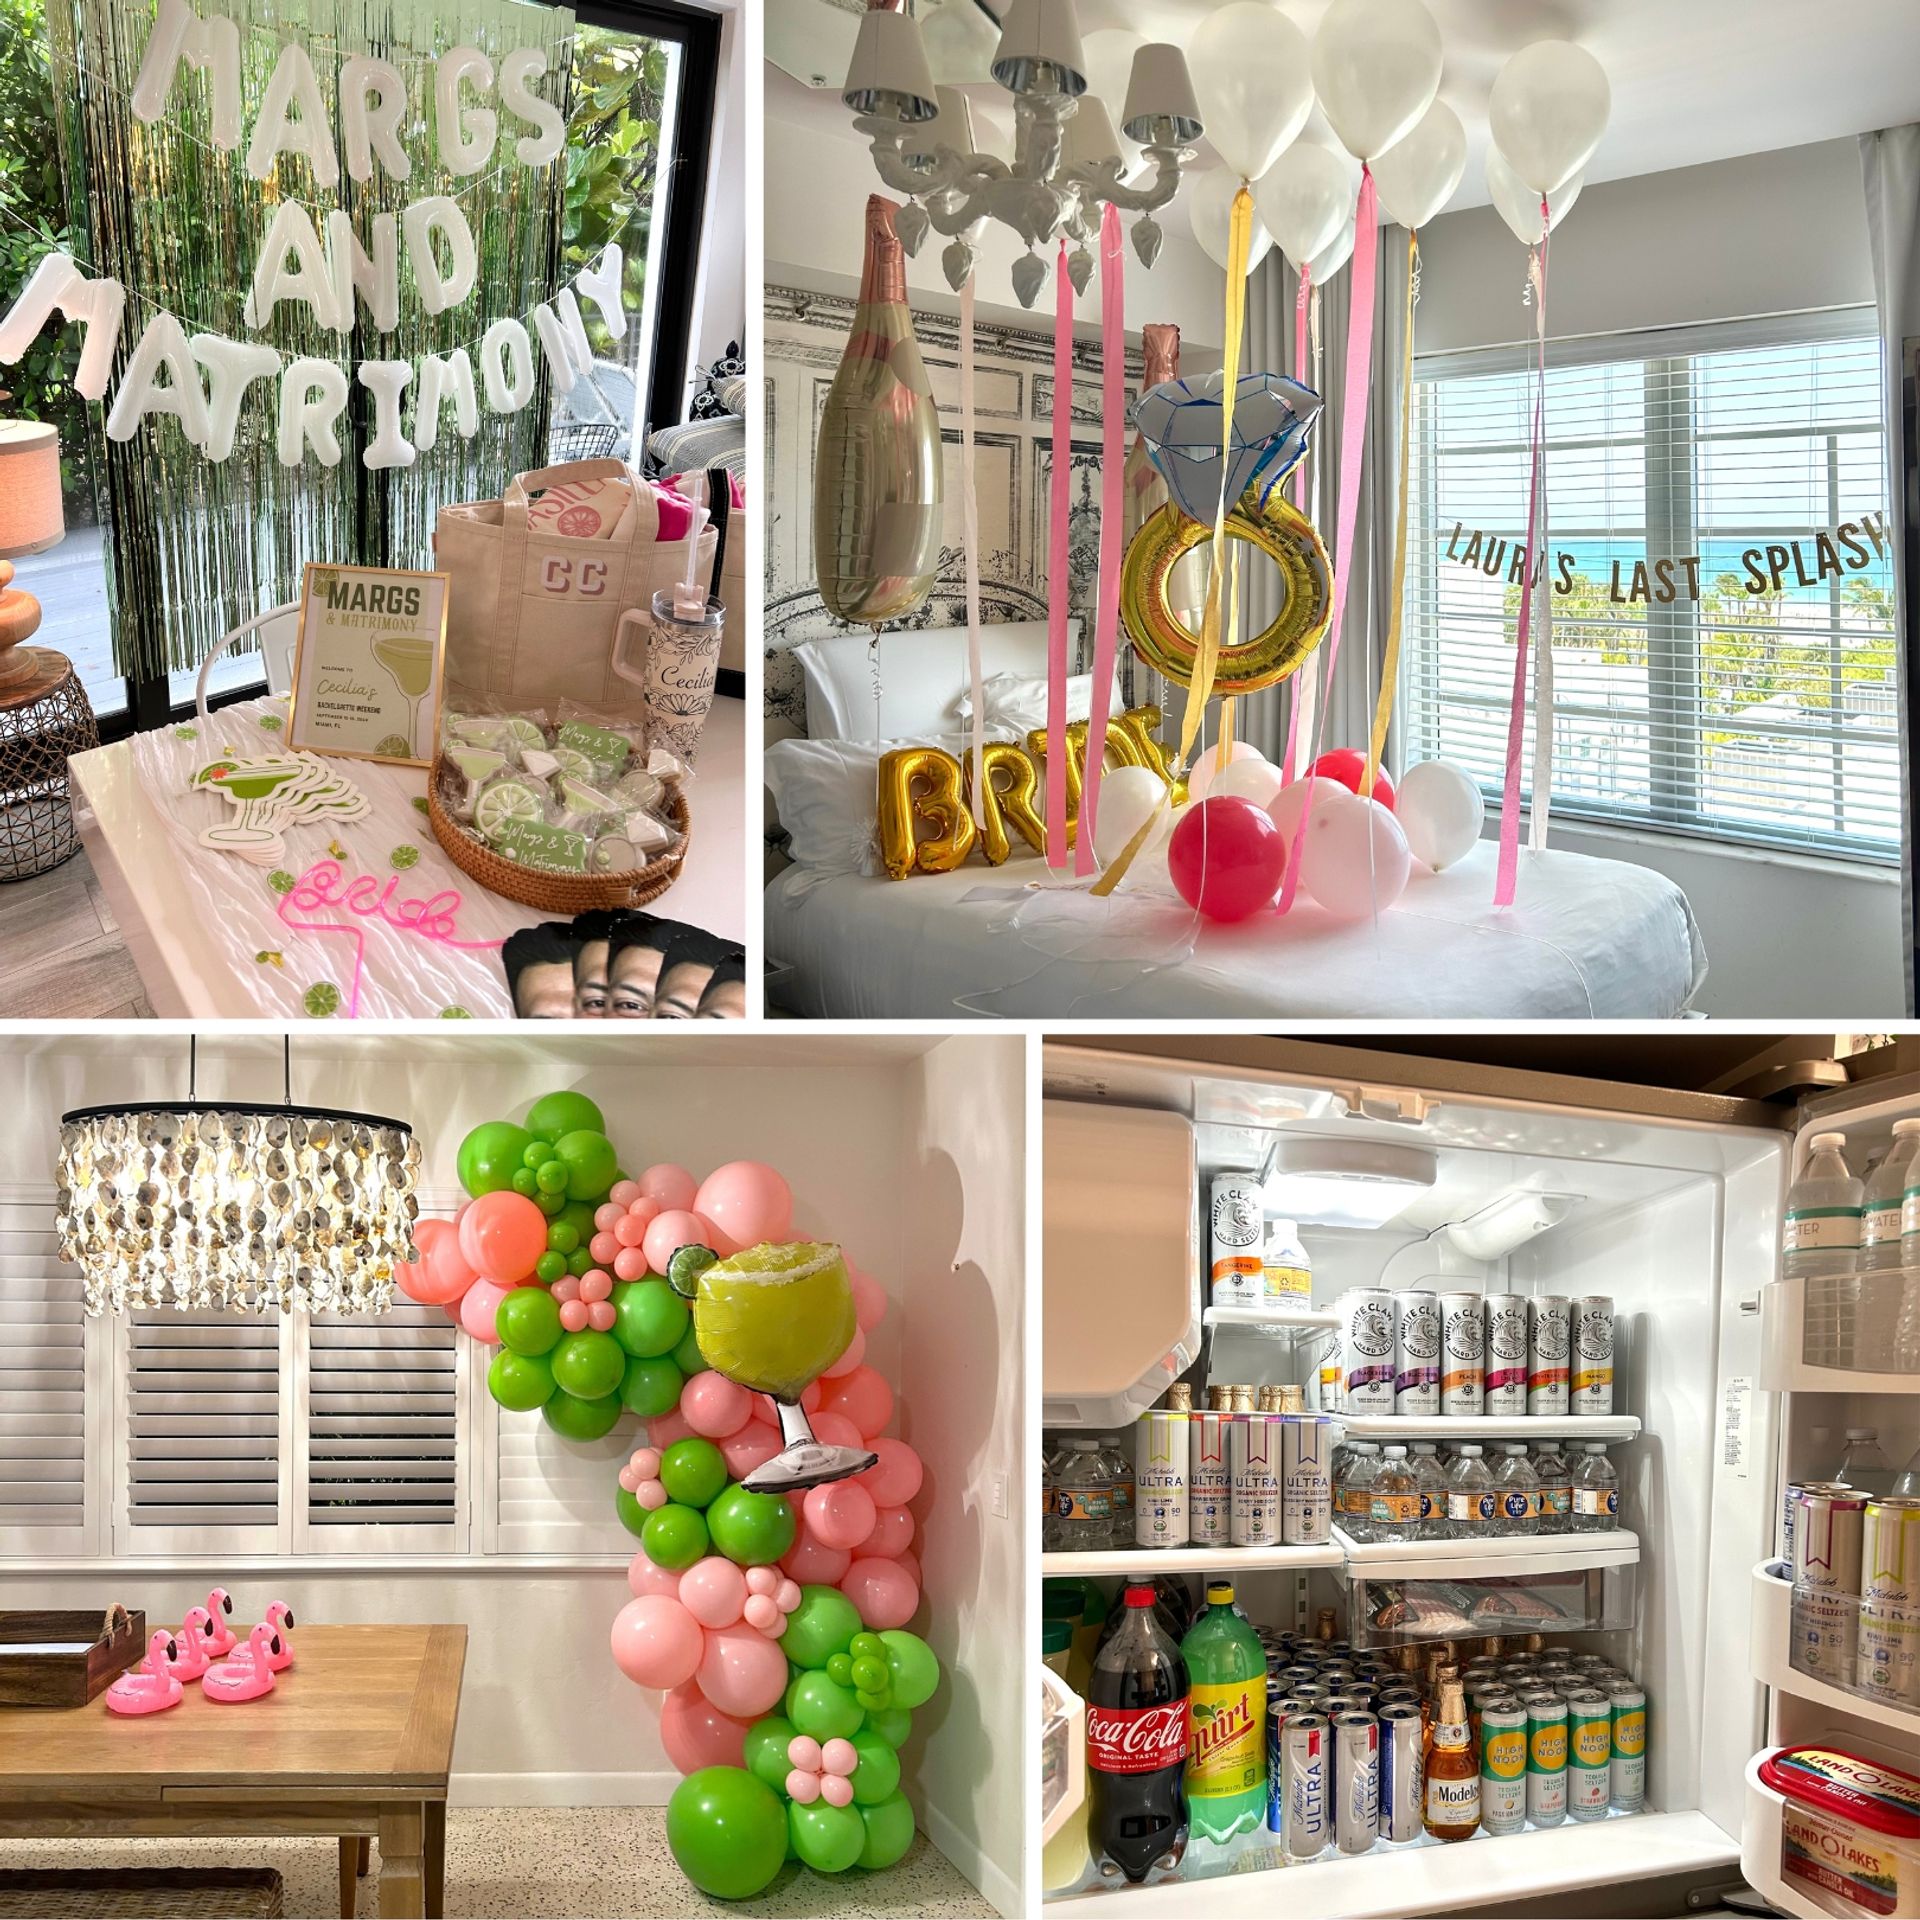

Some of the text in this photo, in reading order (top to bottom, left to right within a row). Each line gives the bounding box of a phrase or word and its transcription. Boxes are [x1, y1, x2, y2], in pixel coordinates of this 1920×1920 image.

[131, 0, 566, 188] MARGS
[244, 196, 477, 333] AND
[0, 243, 623, 469] MATRIMONY
[1445, 521, 1576, 595] LAUR'S
[1610, 556, 1700, 604] LAST
[327, 581, 421, 617] MARGS
[326, 612, 418, 633] & MATRIMONY
[317, 677, 378, 701] Cecilia's
[661, 665, 714, 690] Cecilia
[317, 701, 381, 714] BACHELORETTE WEEKEND
[547, 836, 559, 849] &
[1213, 1193, 1228, 1227] WHITE
[1868, 1213, 1901, 1228] WATE
[1351, 1303, 1393, 1337] WHITE CLAW
[1401, 1309, 1417, 1340] WHITE
[1445, 1309, 1484, 1342] WHITE CLAW
[1488, 1309, 1527, 1341] WHITE CLAW
[1531, 1310, 1569, 1343] WHITE CLAW
[1574, 1311, 1613, 1343] WHITE CLAW
[1139, 1476, 1183, 1487] ULTRA
[1191, 1475, 1231, 1486] ULTRA
[1214, 1487, 1231, 1495] SELTZE
[1236, 1477, 1278, 1488] ULTRA
[1287, 1477, 1329, 1488] ULTRA
[1800, 1572, 1839, 1587] Michelob
[1865, 1586, 1910, 1602] Michelob
[1817, 1606, 1849, 1617] SELTZER
[1087, 1700, 1187, 1753] Coca-Cola
[1190, 1692, 1250, 1768] quirt
[1583, 1733, 1609, 1743] HIGH
[1620, 1731, 1645, 1743] NOO
[1099, 1752, 1132, 1761] ORIGINAL
[1135, 1751, 1160, 1760] TASTE
[1493, 1754, 1524, 1764] NOON
[1496, 1744, 1523, 1755] HIGH
[1538, 1745, 1567, 1757] NOON
[1580, 1742, 1610, 1752] NOON
[1808, 1755, 1854, 1774] LAND
[1853, 1771, 1882, 1784] O
[1878, 1781, 1920, 1801] LAKE
[1307, 1762, 1321, 1834] ULTRA
[1367, 1757, 1378, 1829] ULTRA
[1786, 1820, 1819, 1845] LAND
[1821, 1834, 1840, 1857] O
[1841, 1844, 1881, 1874] LAKES
